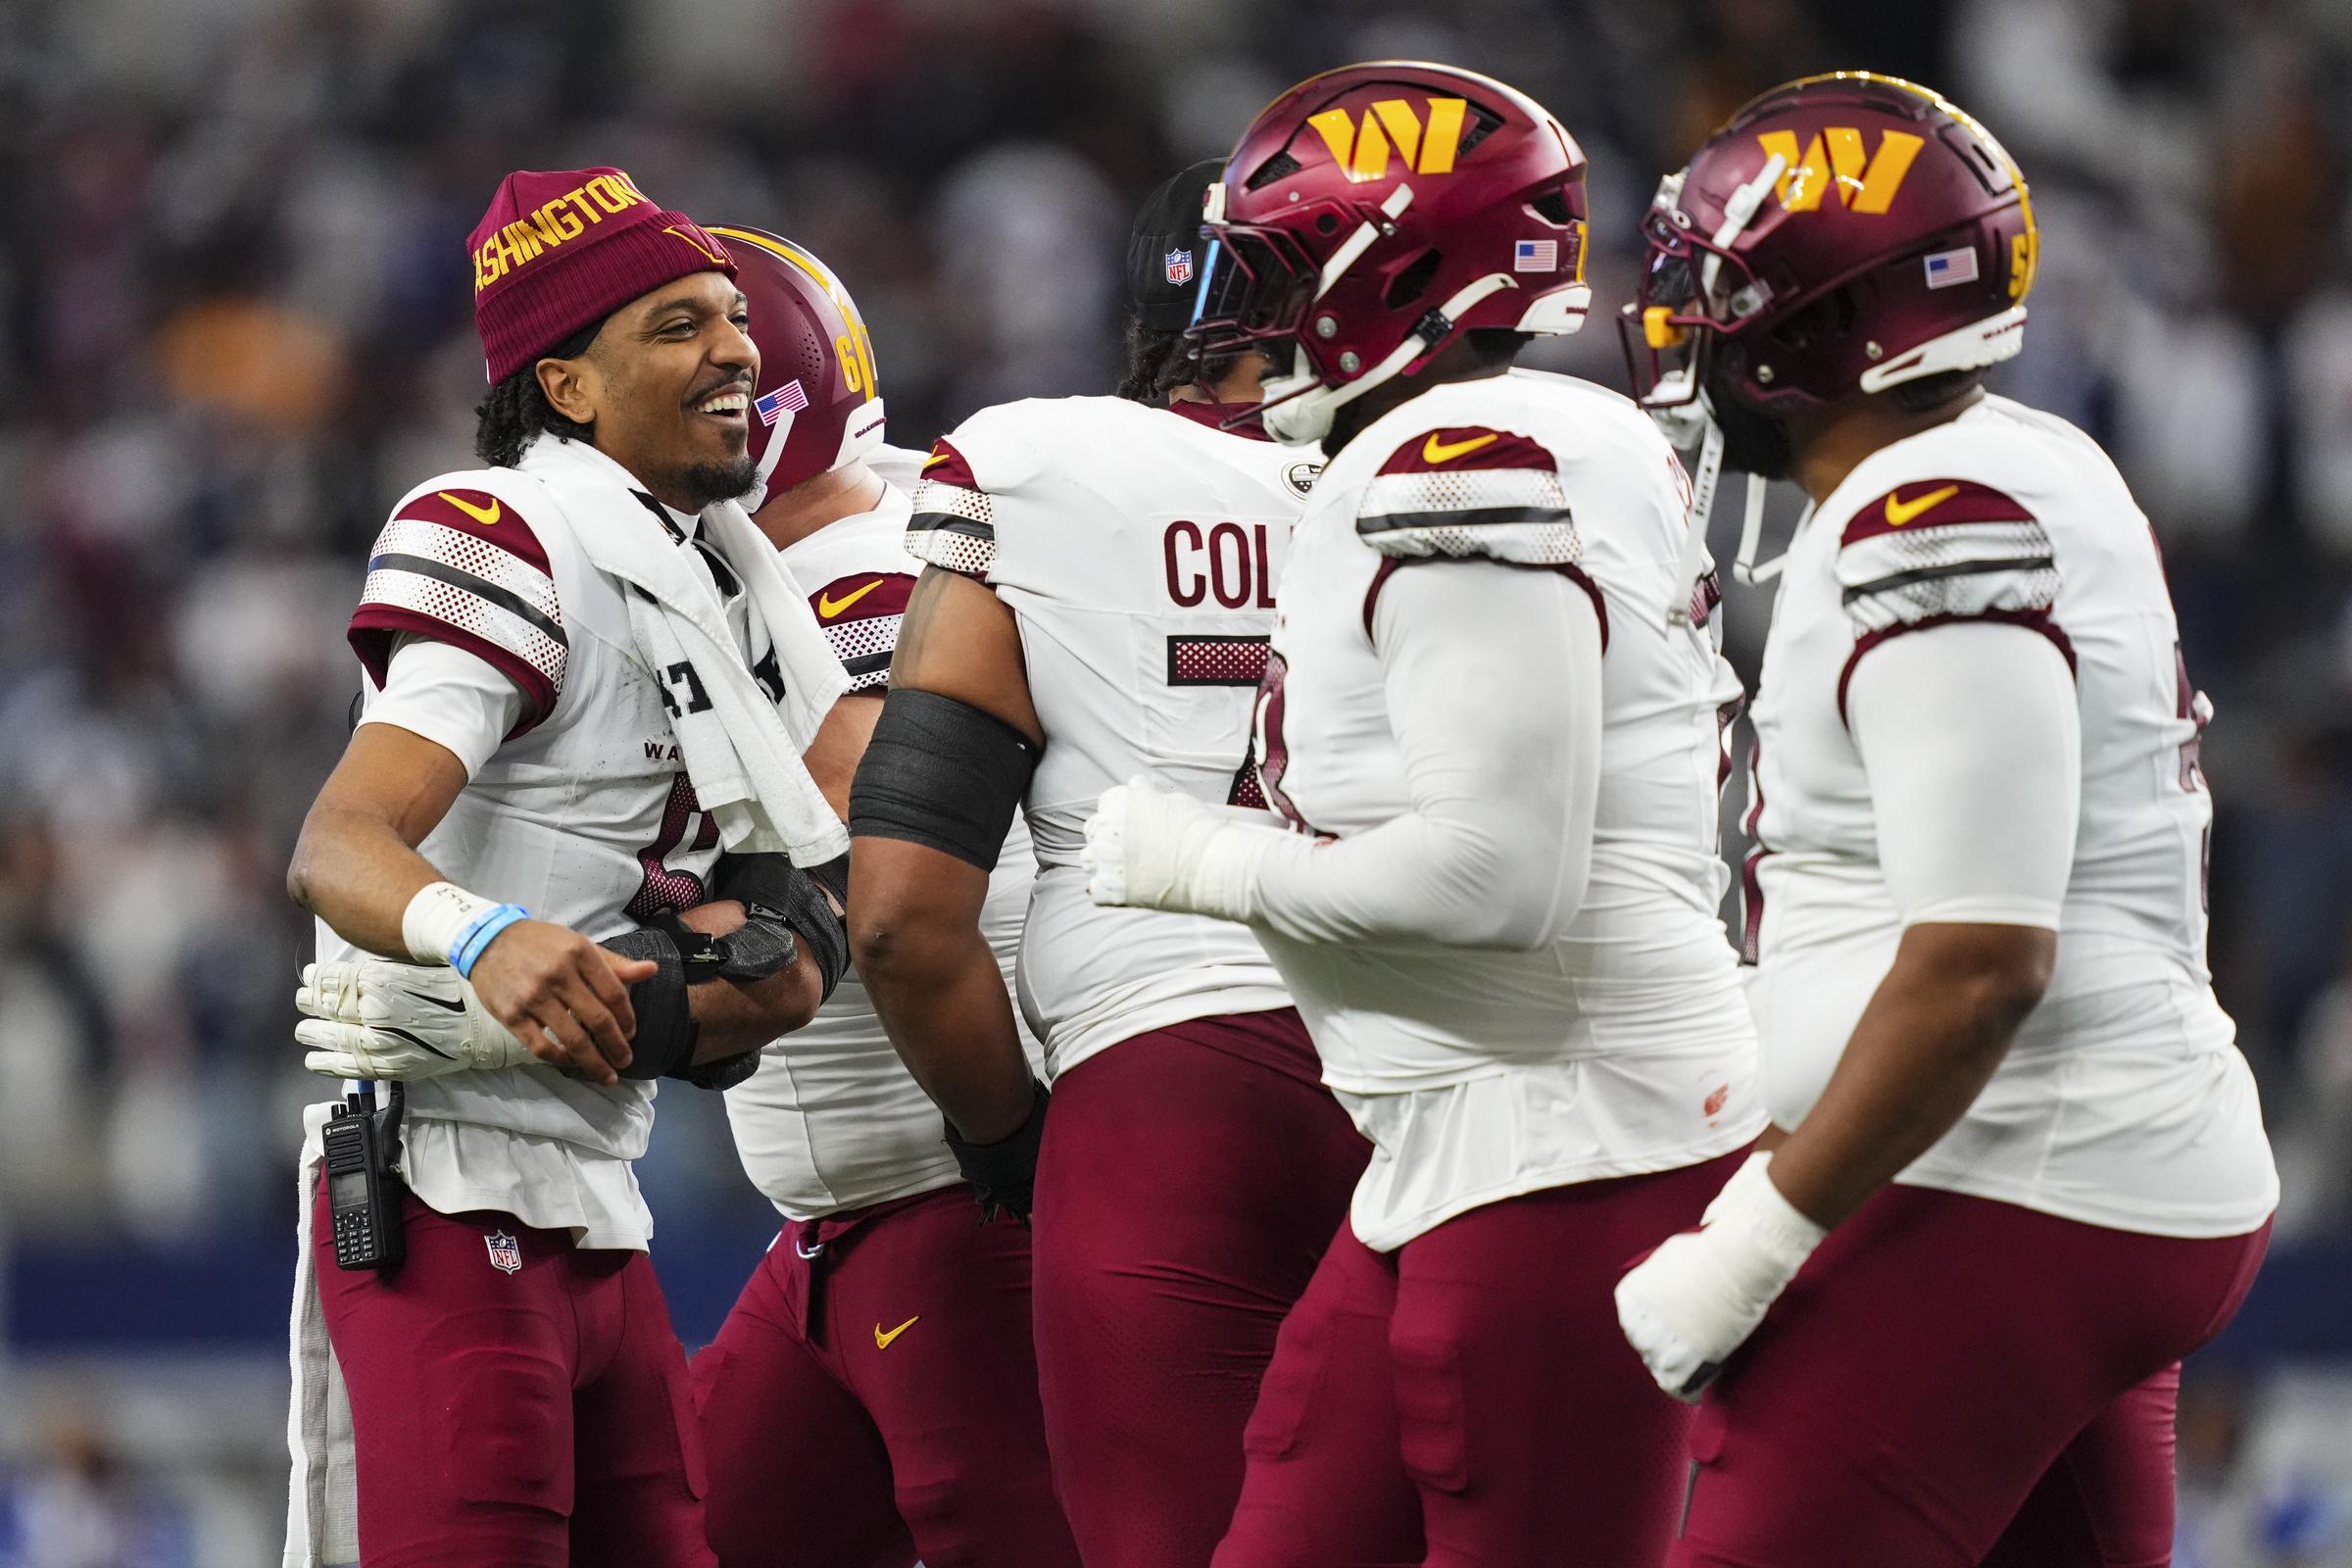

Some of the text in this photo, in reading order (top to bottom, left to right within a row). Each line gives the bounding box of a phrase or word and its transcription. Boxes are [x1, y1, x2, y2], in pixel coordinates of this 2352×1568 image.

[1169, 264, 1190, 280] NFL
[644, 742, 679, 761] WA
[494, 1250, 517, 1266] NFL
